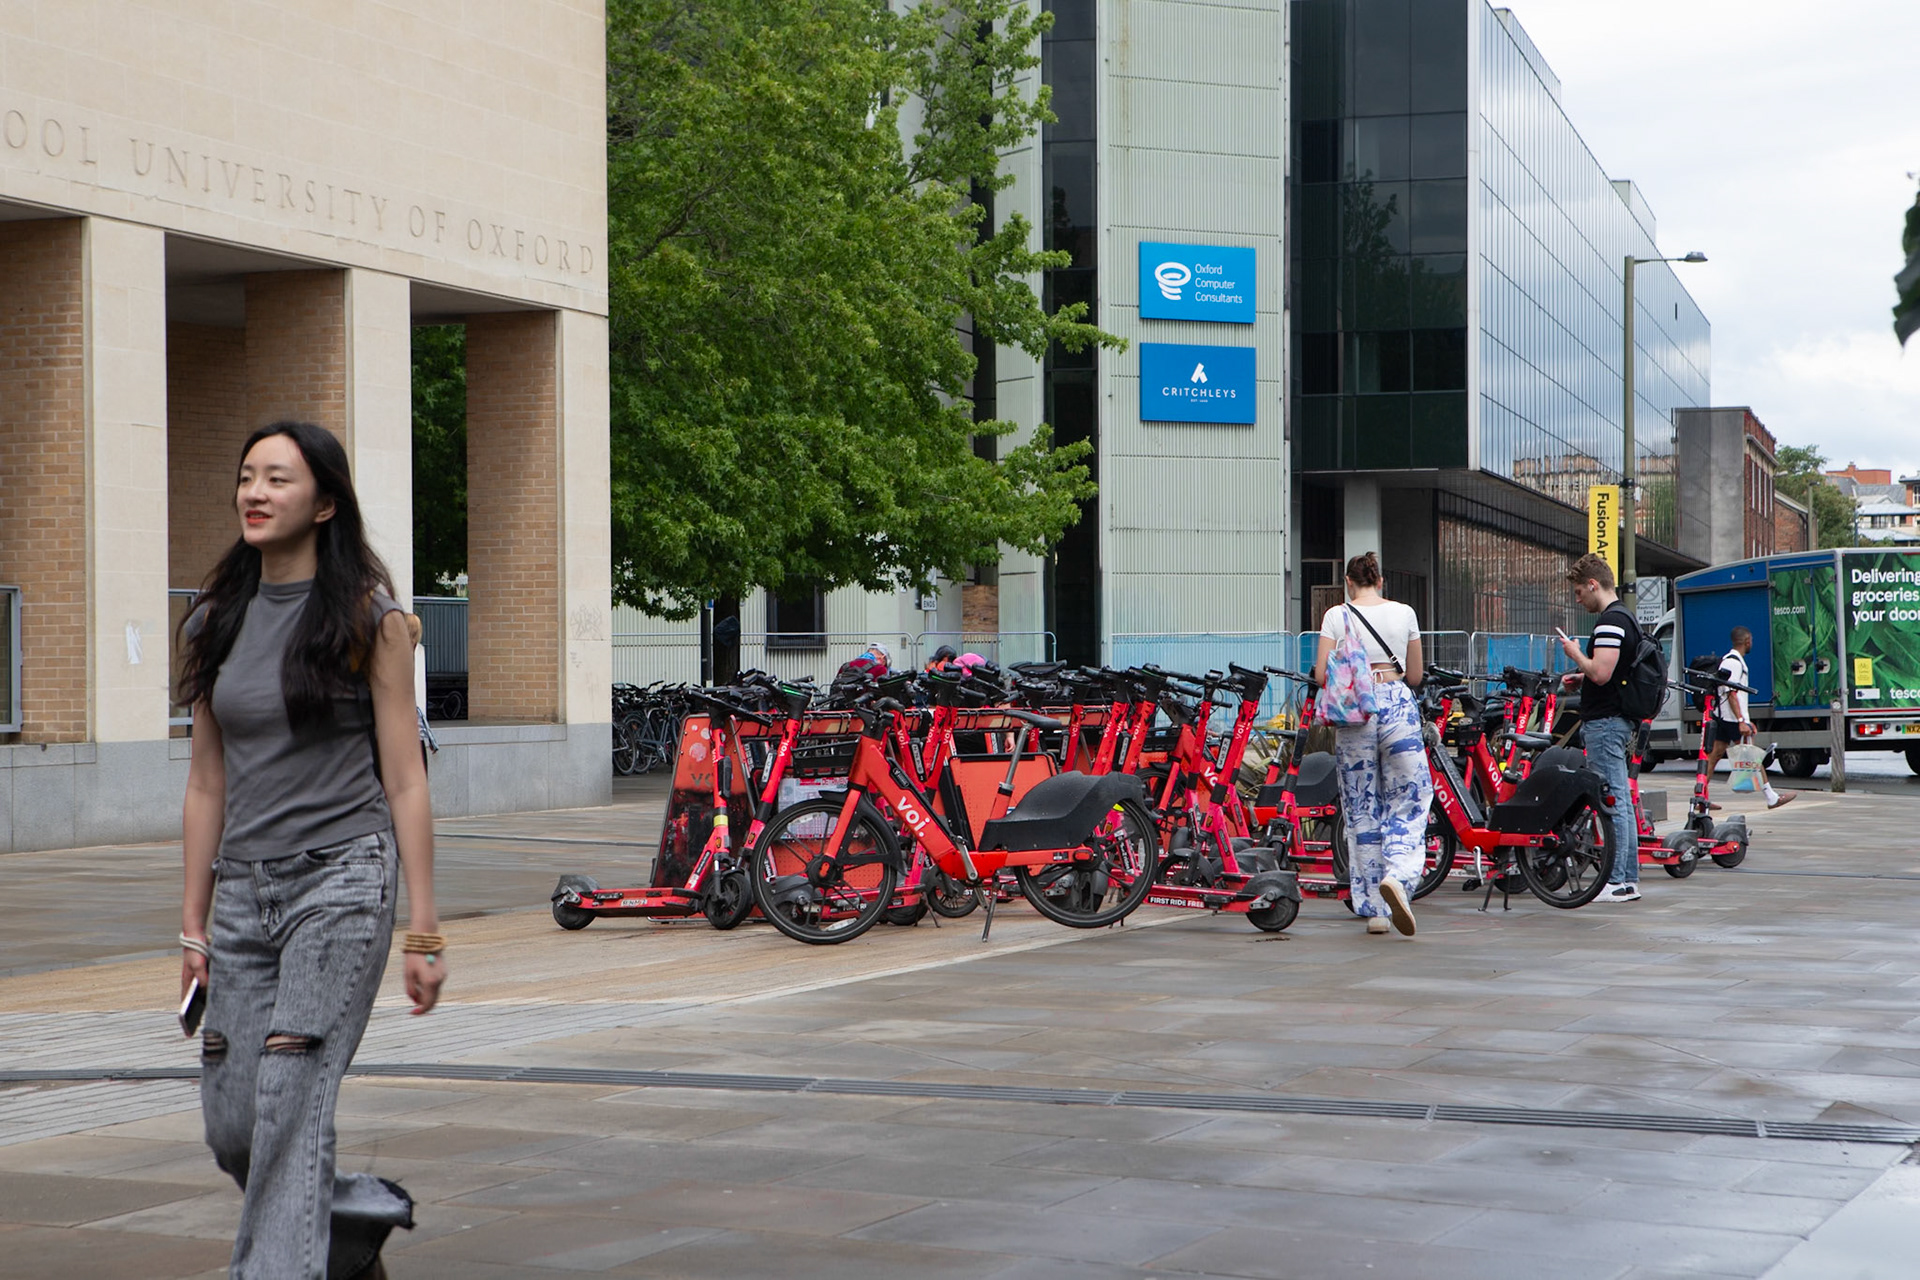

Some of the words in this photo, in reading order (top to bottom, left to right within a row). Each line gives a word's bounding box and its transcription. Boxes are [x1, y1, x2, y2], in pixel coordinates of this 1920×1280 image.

[128, 137, 390, 232] UNIVERSITY
[408, 203, 447, 244] OF
[466, 217, 595, 275] OXFORD
[1194, 263, 1223, 275] Oxford
[1194, 277, 1236, 290] Computer
[1194, 291, 1243, 304] Consultants
[1161, 386, 1237, 399] CRITCHLEYS
[1851, 567, 1920, 586] Delivering
[1852, 586, 1920, 606] groceries
[1773, 605, 1806, 616] tesco.com
[1852, 610, 1886, 626] your
[1150, 896, 1170, 905] FIRST
[1170, 898, 1187, 907] RIDE
[1187, 900, 1205, 908] FREE
